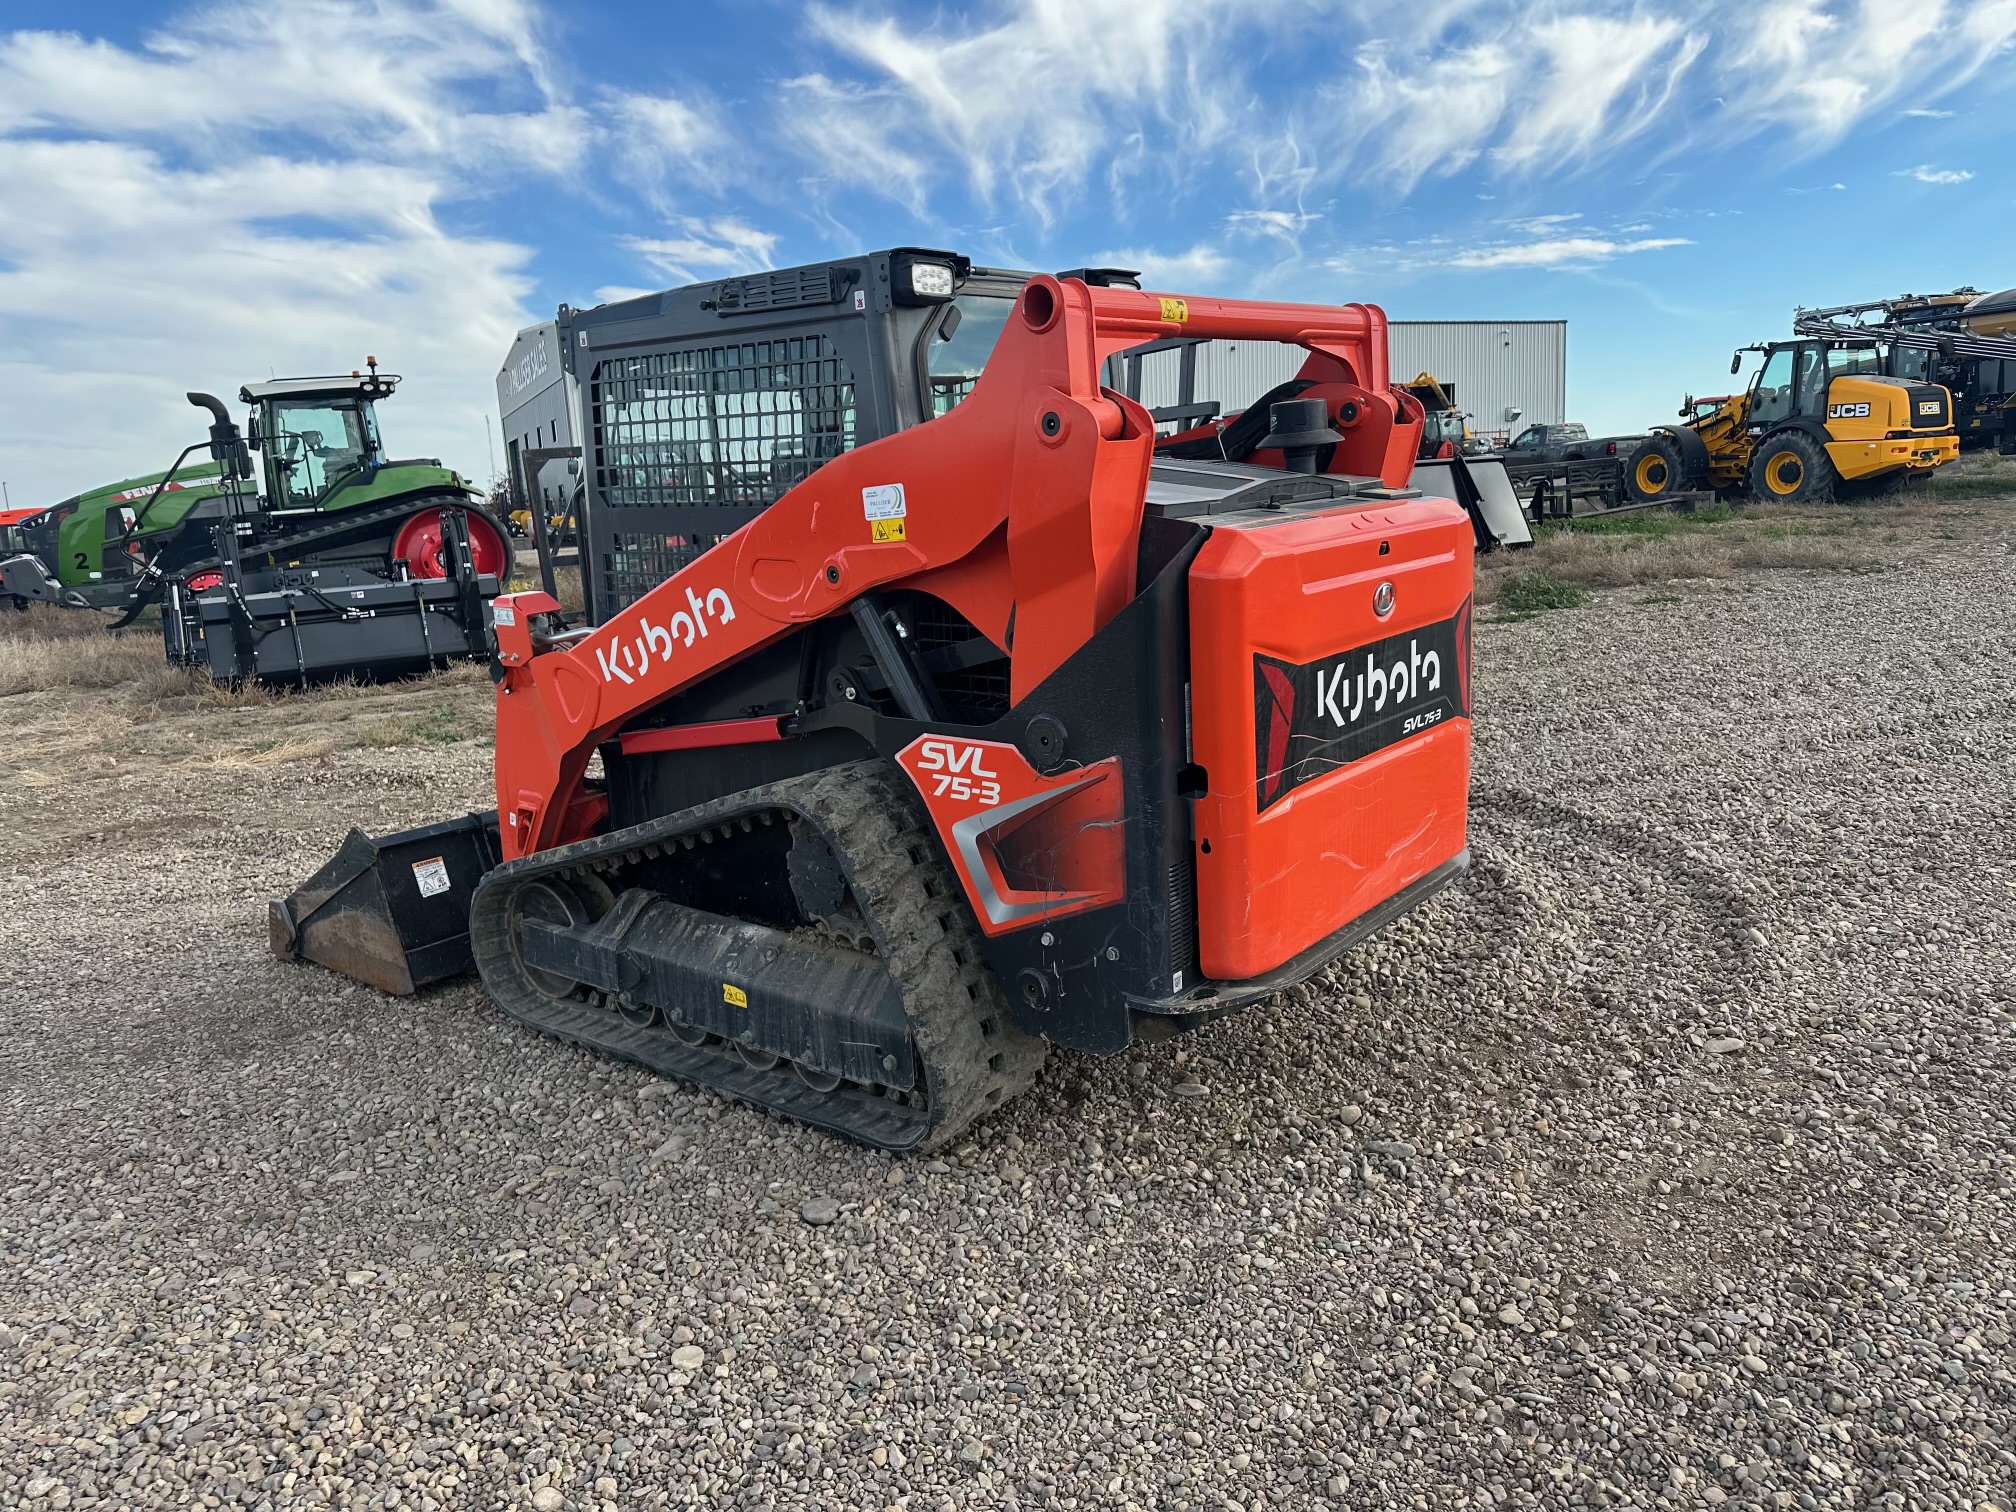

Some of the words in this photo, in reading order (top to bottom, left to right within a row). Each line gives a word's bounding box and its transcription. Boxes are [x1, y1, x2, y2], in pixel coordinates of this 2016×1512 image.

[1829, 403, 1869, 418] JCB
[1920, 404, 1938, 413] JCB
[74, 552, 90, 570] 2
[595, 586, 736, 685] Kubota
[1317, 638, 1441, 727] Kubota
[917, 740, 998, 779] SVL
[931, 774, 1001, 805] 75-3
